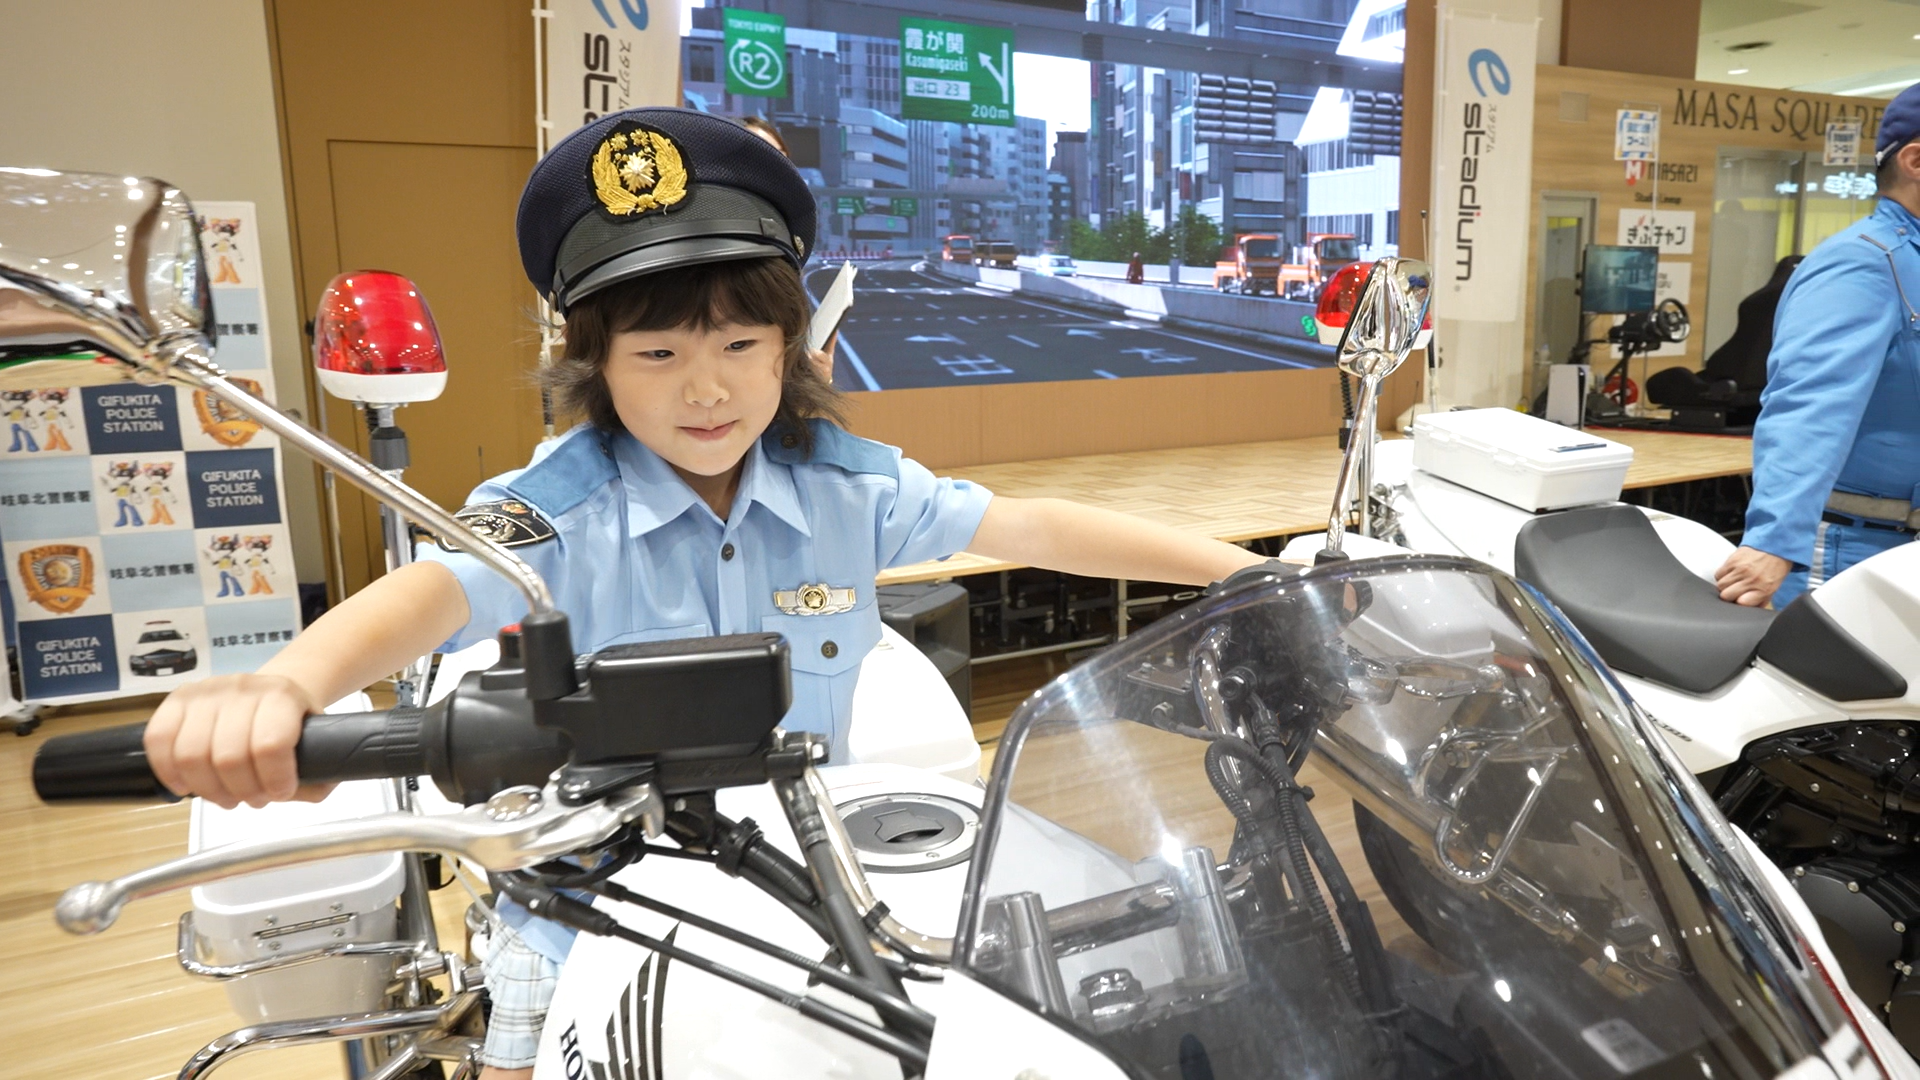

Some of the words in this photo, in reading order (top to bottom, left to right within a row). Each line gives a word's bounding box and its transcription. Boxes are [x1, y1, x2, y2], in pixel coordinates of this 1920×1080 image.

[905, 28, 964, 54] 霞が関
[739, 51, 772, 80] R2
[905, 52, 968, 73] Kasumigaseki
[914, 81, 938, 94] 出口
[945, 82, 960, 96] 23
[971, 103, 1009, 120] 200m
[1672, 88, 1759, 131] MASA
[97, 394, 163, 407] GIFUKITA
[105, 407, 157, 419] POLICE
[103, 421, 164, 433] STATION
[201, 469, 262, 482] GIFUKITA
[208, 482, 257, 494] POLICE
[206, 494, 264, 507] STATION
[35, 636, 101, 652] GIFUKITA
[43, 649, 96, 664] POLICE
[40, 662, 102, 678] STATION
[560, 1018, 588, 1080] HO
